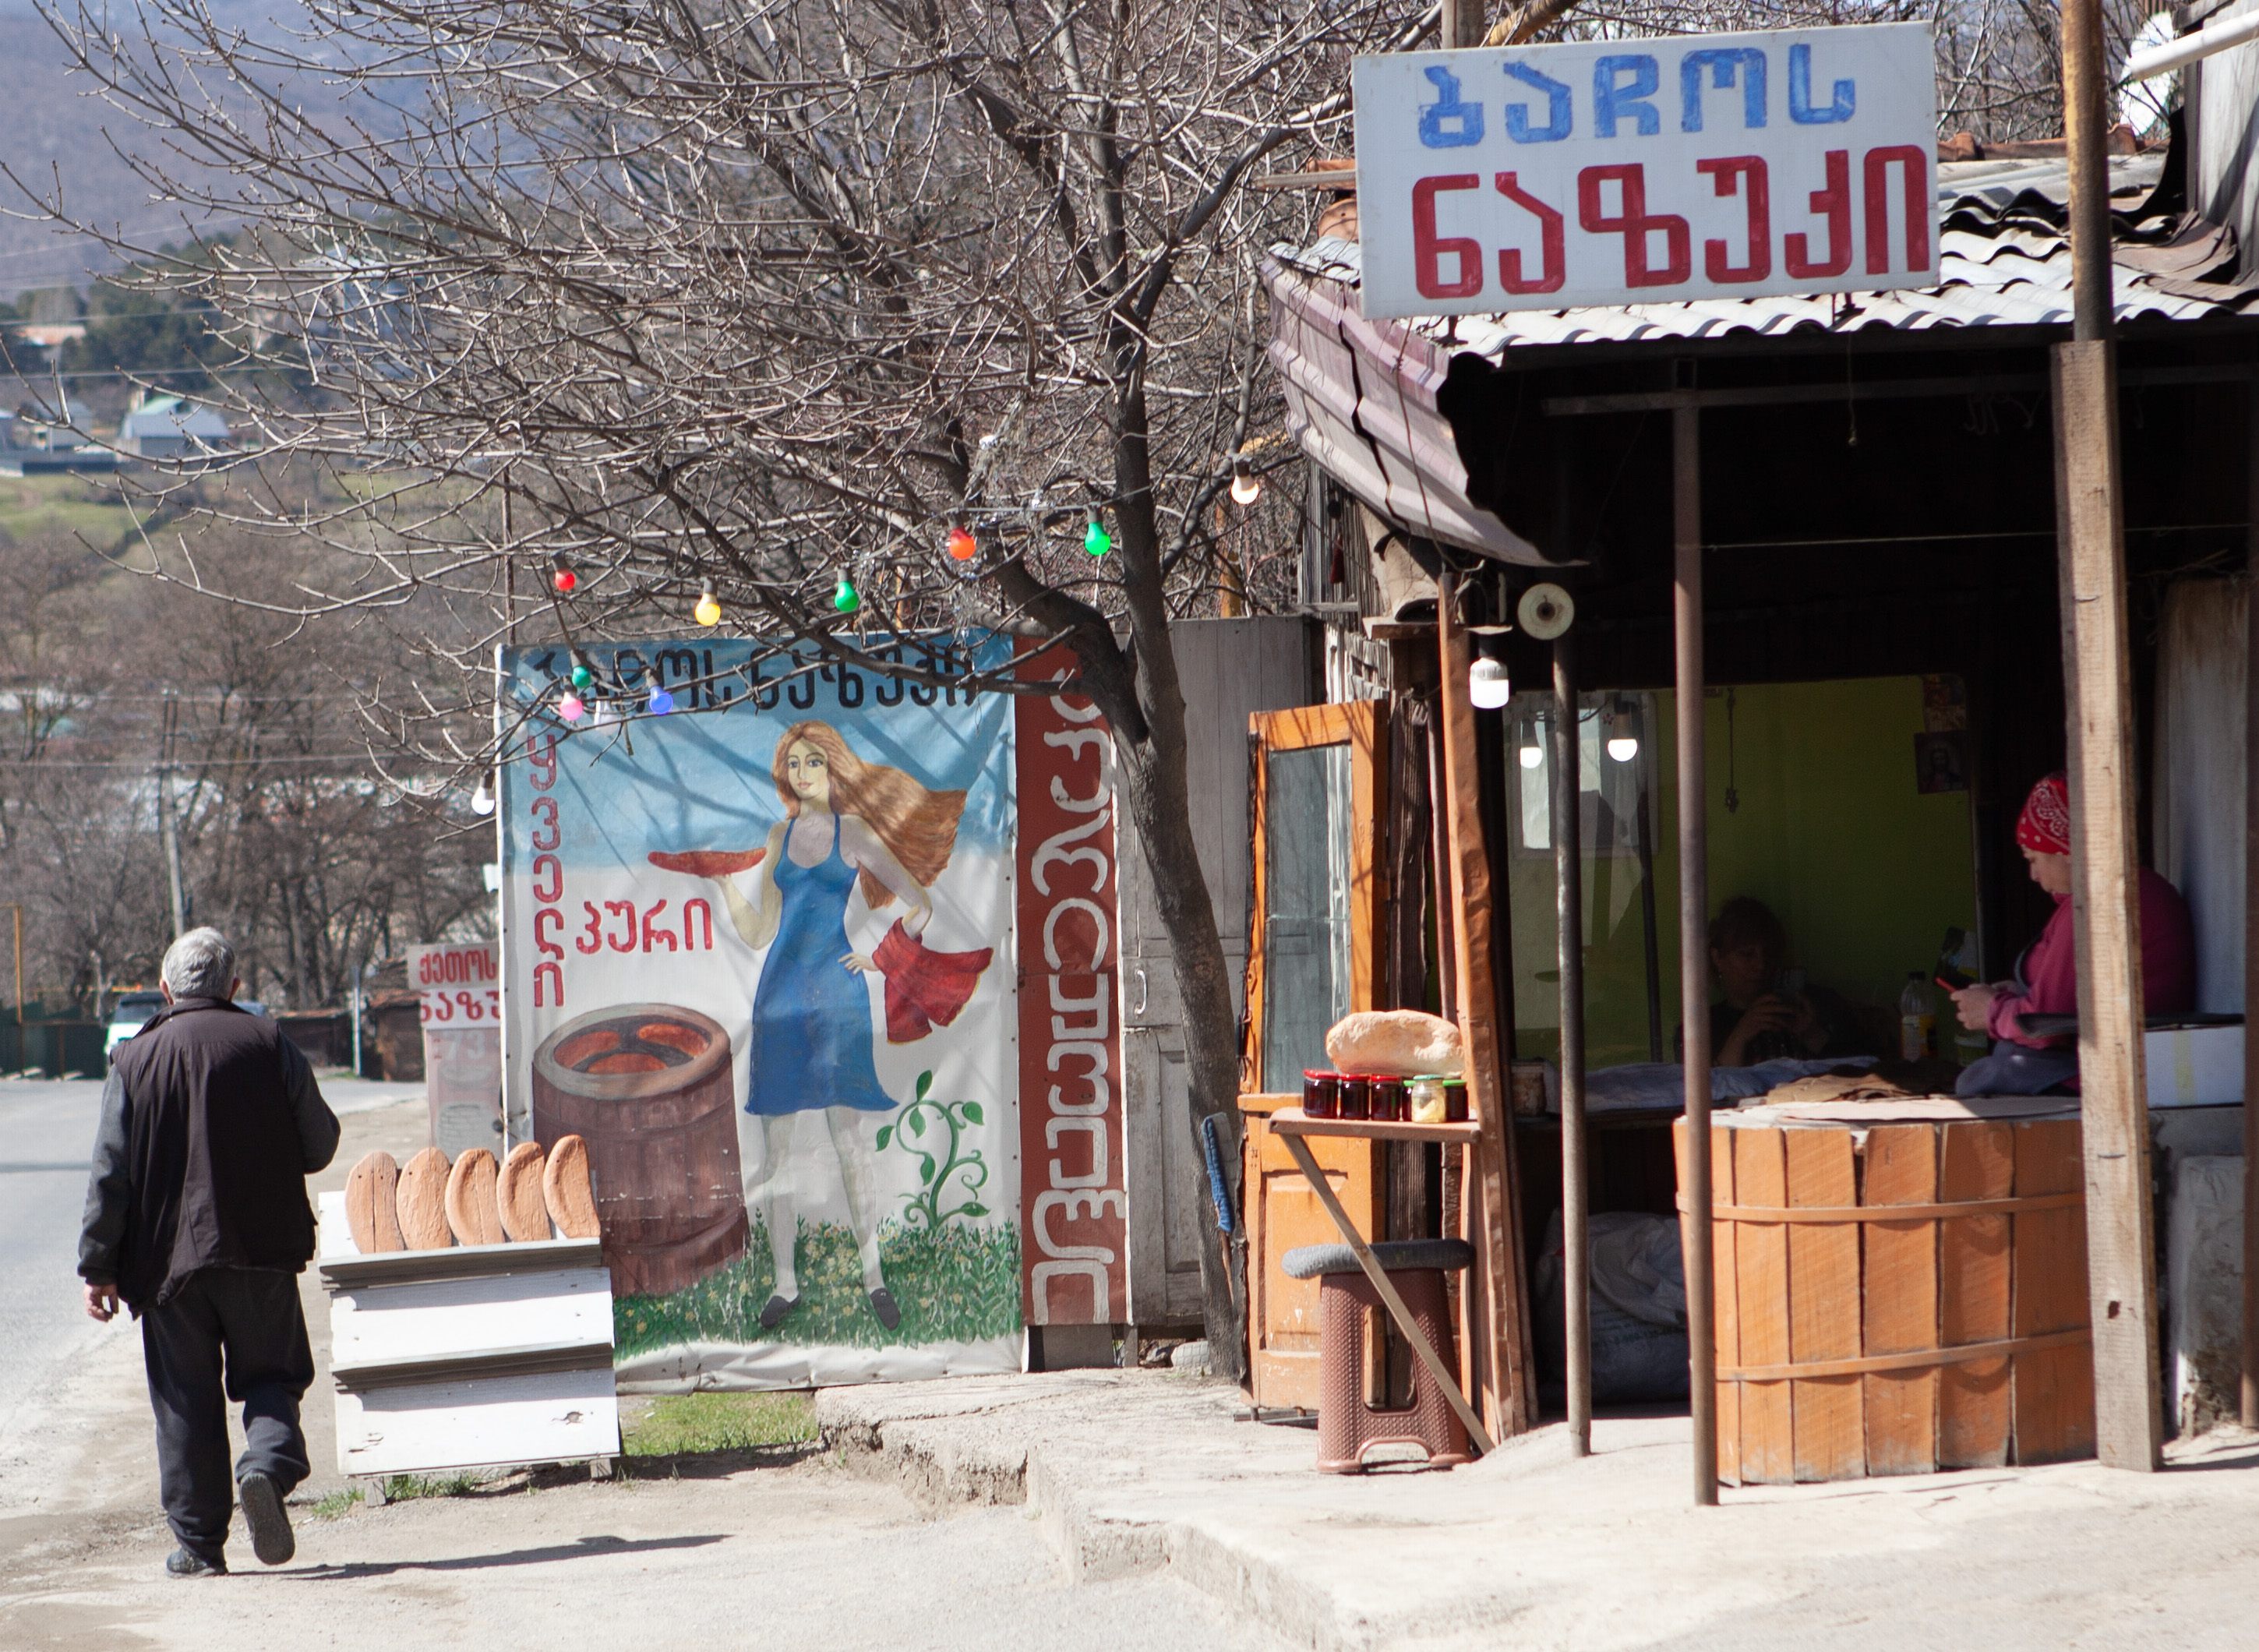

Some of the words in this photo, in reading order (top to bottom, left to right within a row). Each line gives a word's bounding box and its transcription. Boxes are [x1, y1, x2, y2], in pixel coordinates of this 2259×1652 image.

[1411, 145, 1931, 300] ნაზუქი
[527, 734, 565, 1008] ყველი
[418, 948, 497, 986] ქეთოს
[575, 897, 714, 955] პური
